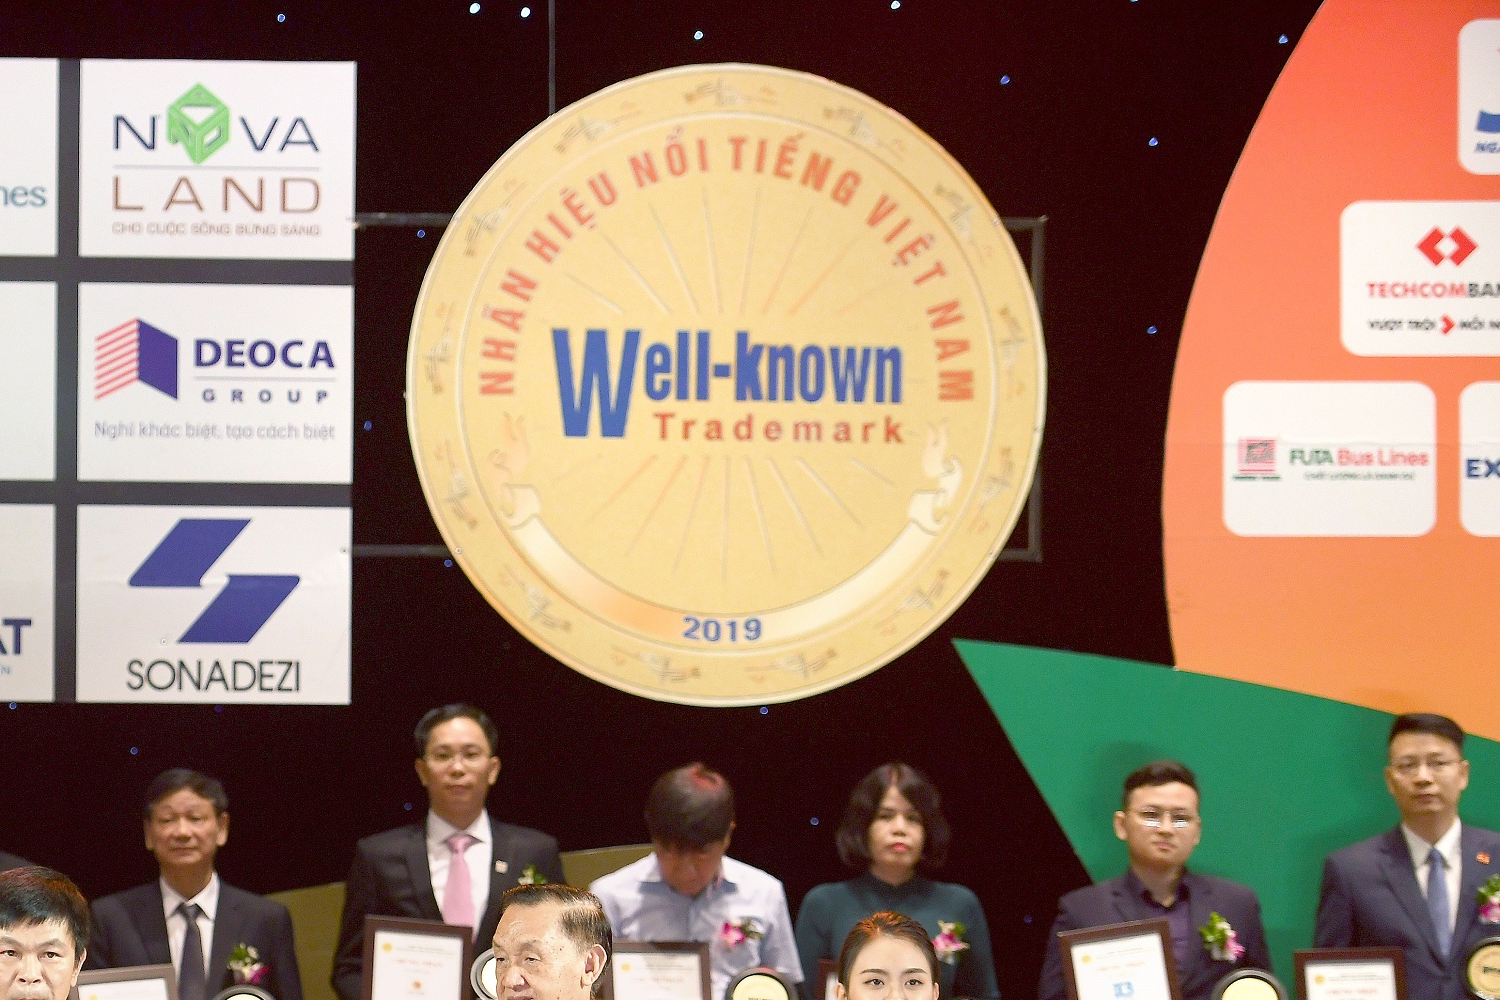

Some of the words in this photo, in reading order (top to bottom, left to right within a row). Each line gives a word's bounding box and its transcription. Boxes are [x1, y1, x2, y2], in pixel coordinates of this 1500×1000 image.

[112, 175, 321, 213] LAND
[479, 270, 538, 396] NHÃN
[525, 171, 620, 264] HIỆU
[628, 126, 709, 190] NỔI
[728, 131, 862, 207] TIẾNG
[865, 192, 946, 287] VIỆT
[926, 299, 975, 403] NAM
[193, 339, 335, 368] DEOCA
[201, 388, 329, 403] GROUP
[551, 328, 905, 439] Well-known
[652, 410, 905, 445] Trademark
[1337, 449, 1373, 466] Bus
[682, 617, 764, 643] 2019
[126, 659, 300, 692] SONADEZI
